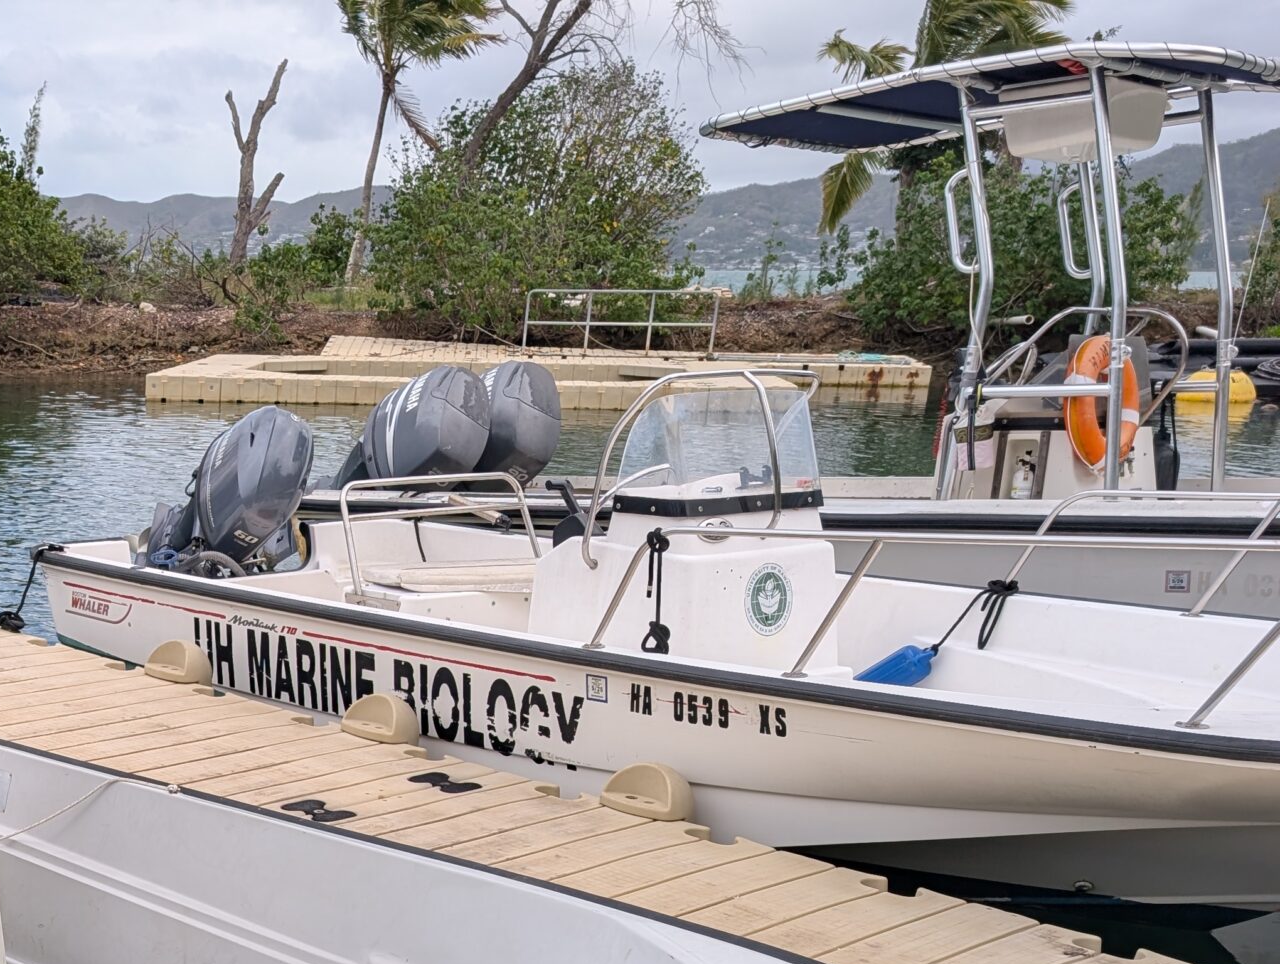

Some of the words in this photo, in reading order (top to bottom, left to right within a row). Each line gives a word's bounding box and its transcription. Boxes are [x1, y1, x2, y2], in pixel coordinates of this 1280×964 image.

[233, 529, 259, 544] 60
[72, 596, 110, 616] WHALER
[228, 614, 282, 634] Montauk
[280, 625, 298, 636] 170
[247, 628, 375, 715] MARINE
[630, 683, 652, 716] HA
[673, 691, 730, 729] 0539
[759, 704, 787, 737] XS
